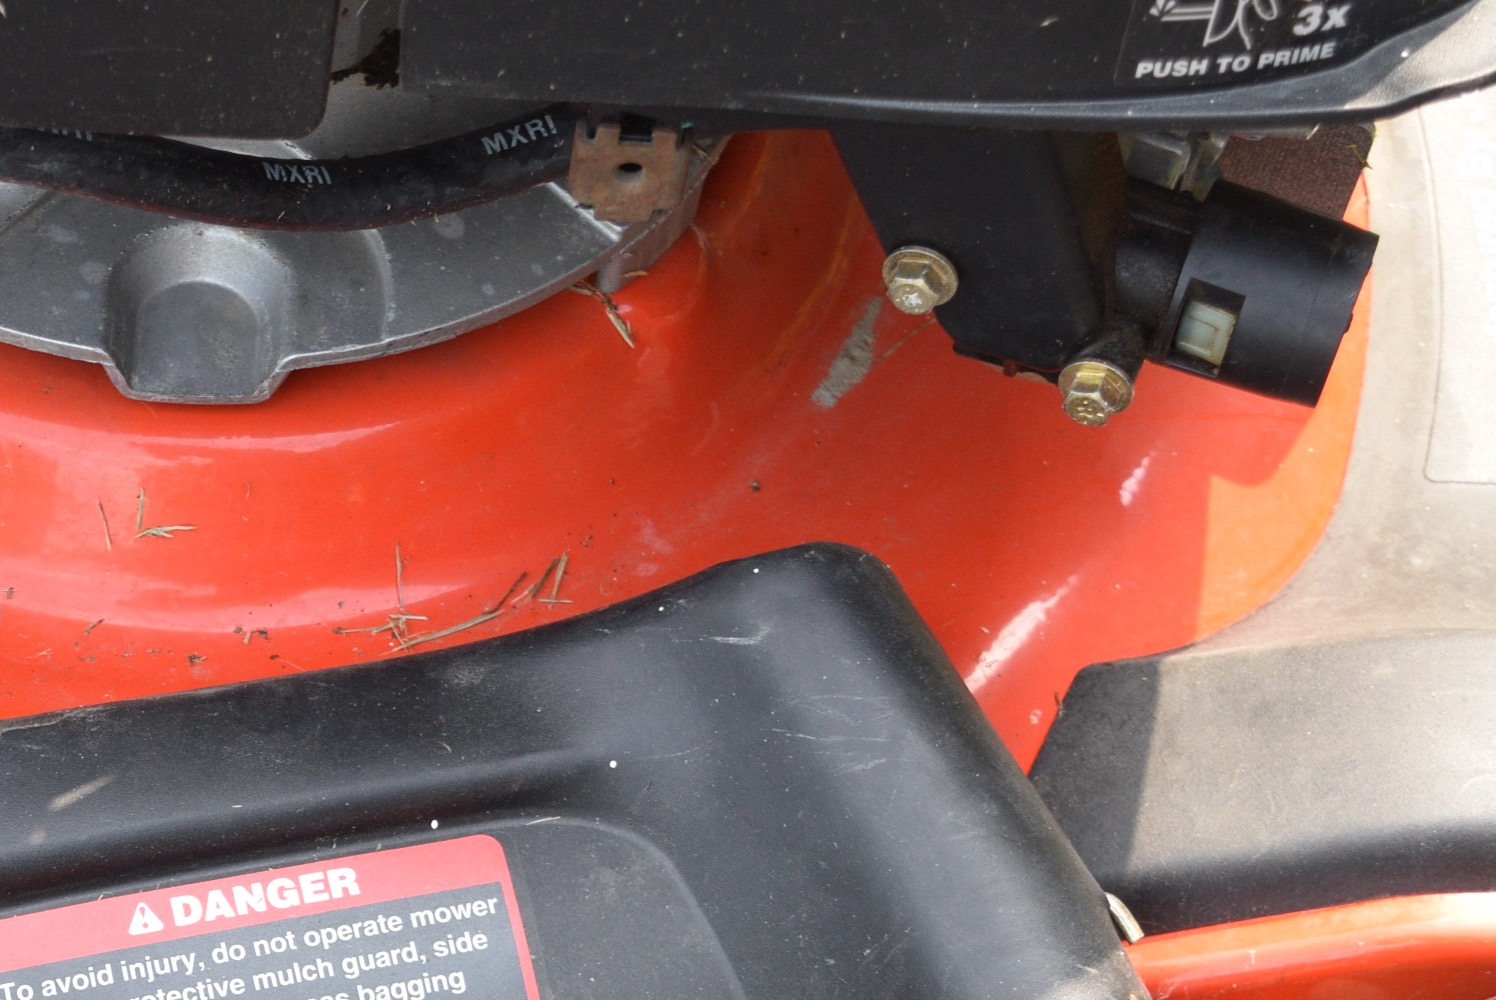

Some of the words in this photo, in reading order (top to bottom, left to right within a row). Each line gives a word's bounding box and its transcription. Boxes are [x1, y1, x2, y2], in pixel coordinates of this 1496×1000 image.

[1135, 59, 1208, 79] PUSH
[1217, 56, 1251, 74] TO
[1258, 43, 1336, 70] PRIME
[170, 868, 360, 927] DANGER
[41, 964, 114, 997] avoid
[121, 952, 205, 982] injury,
[212, 942, 245, 964] do
[253, 931, 296, 957] not
[304, 915, 403, 949] operate
[410, 898, 498, 928] mower
[253, 958, 334, 991] mulch
[342, 941, 426, 979] guard,
[433, 931, 488, 957] side
